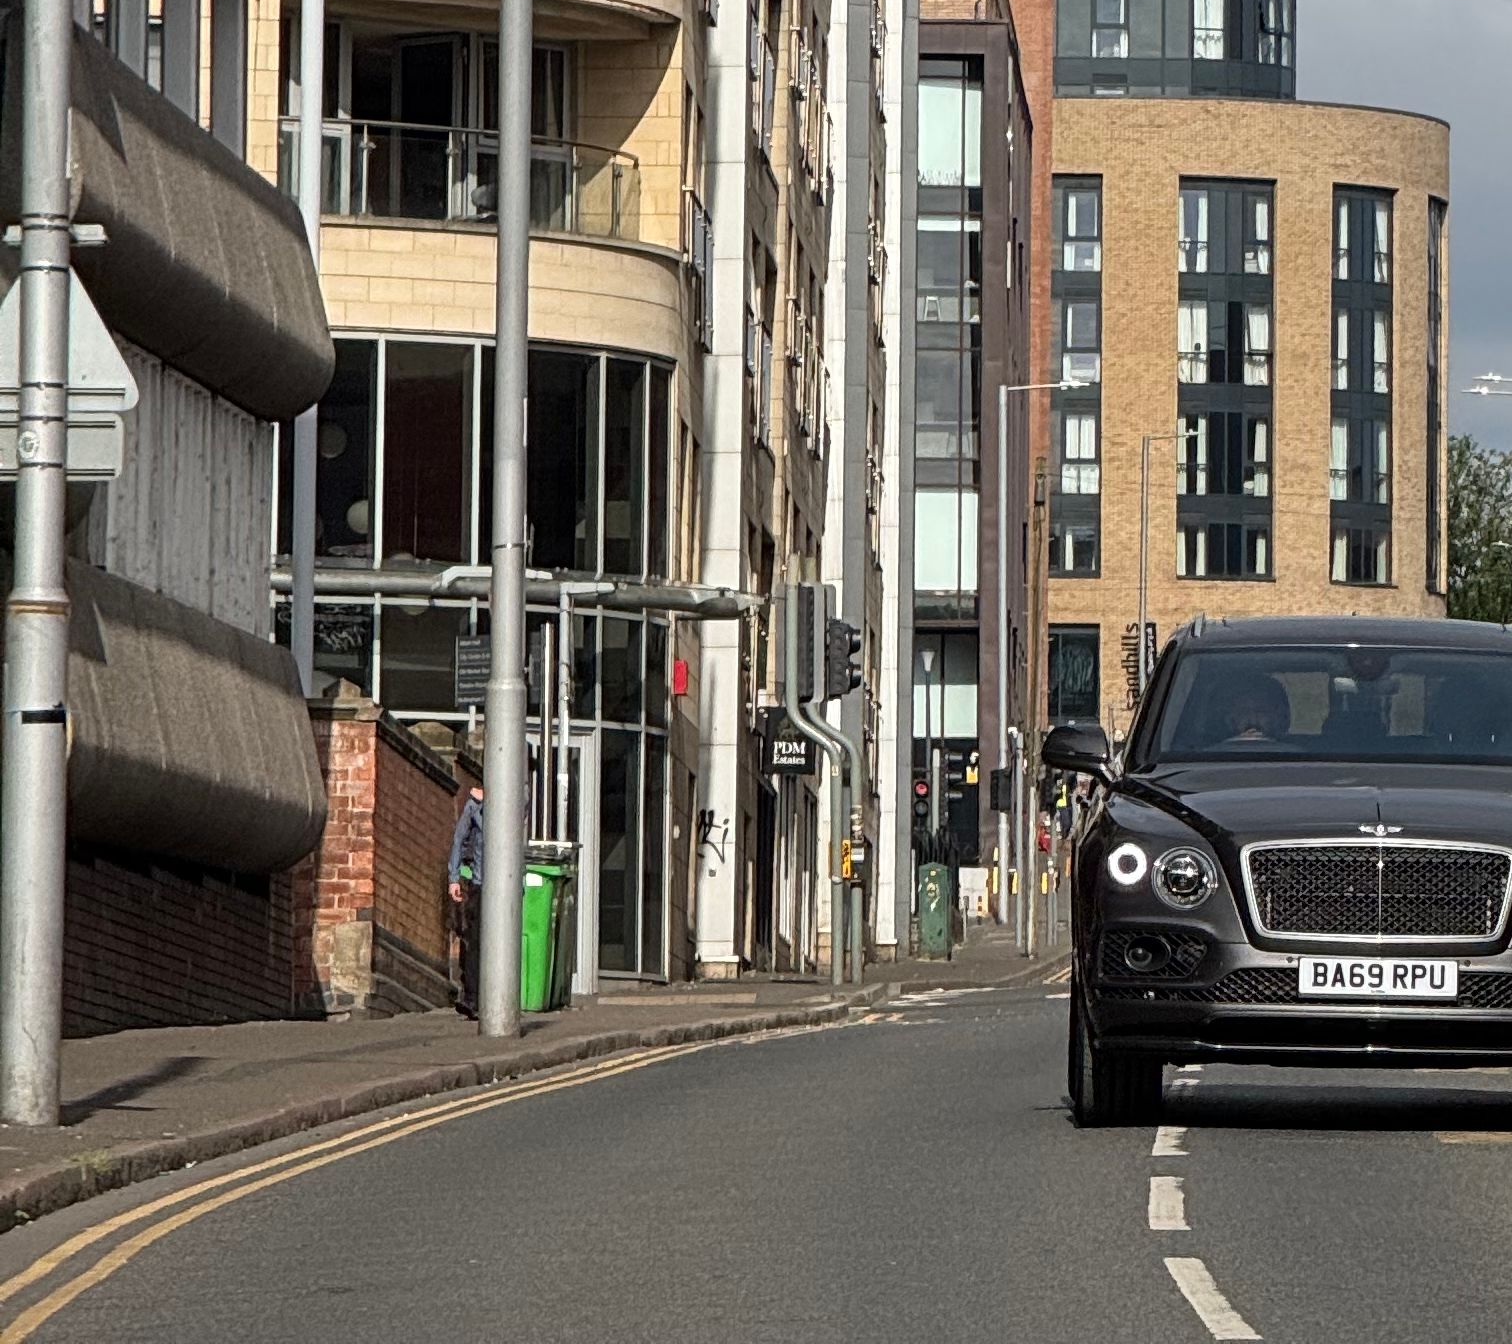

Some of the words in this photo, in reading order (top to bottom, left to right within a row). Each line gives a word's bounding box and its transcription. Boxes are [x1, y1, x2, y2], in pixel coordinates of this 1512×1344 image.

[774, 741, 806, 754] PDM
[773, 754, 806, 765] Estates
[1312, 962, 1384, 988] BA69
[1392, 964, 1446, 990] RPU
